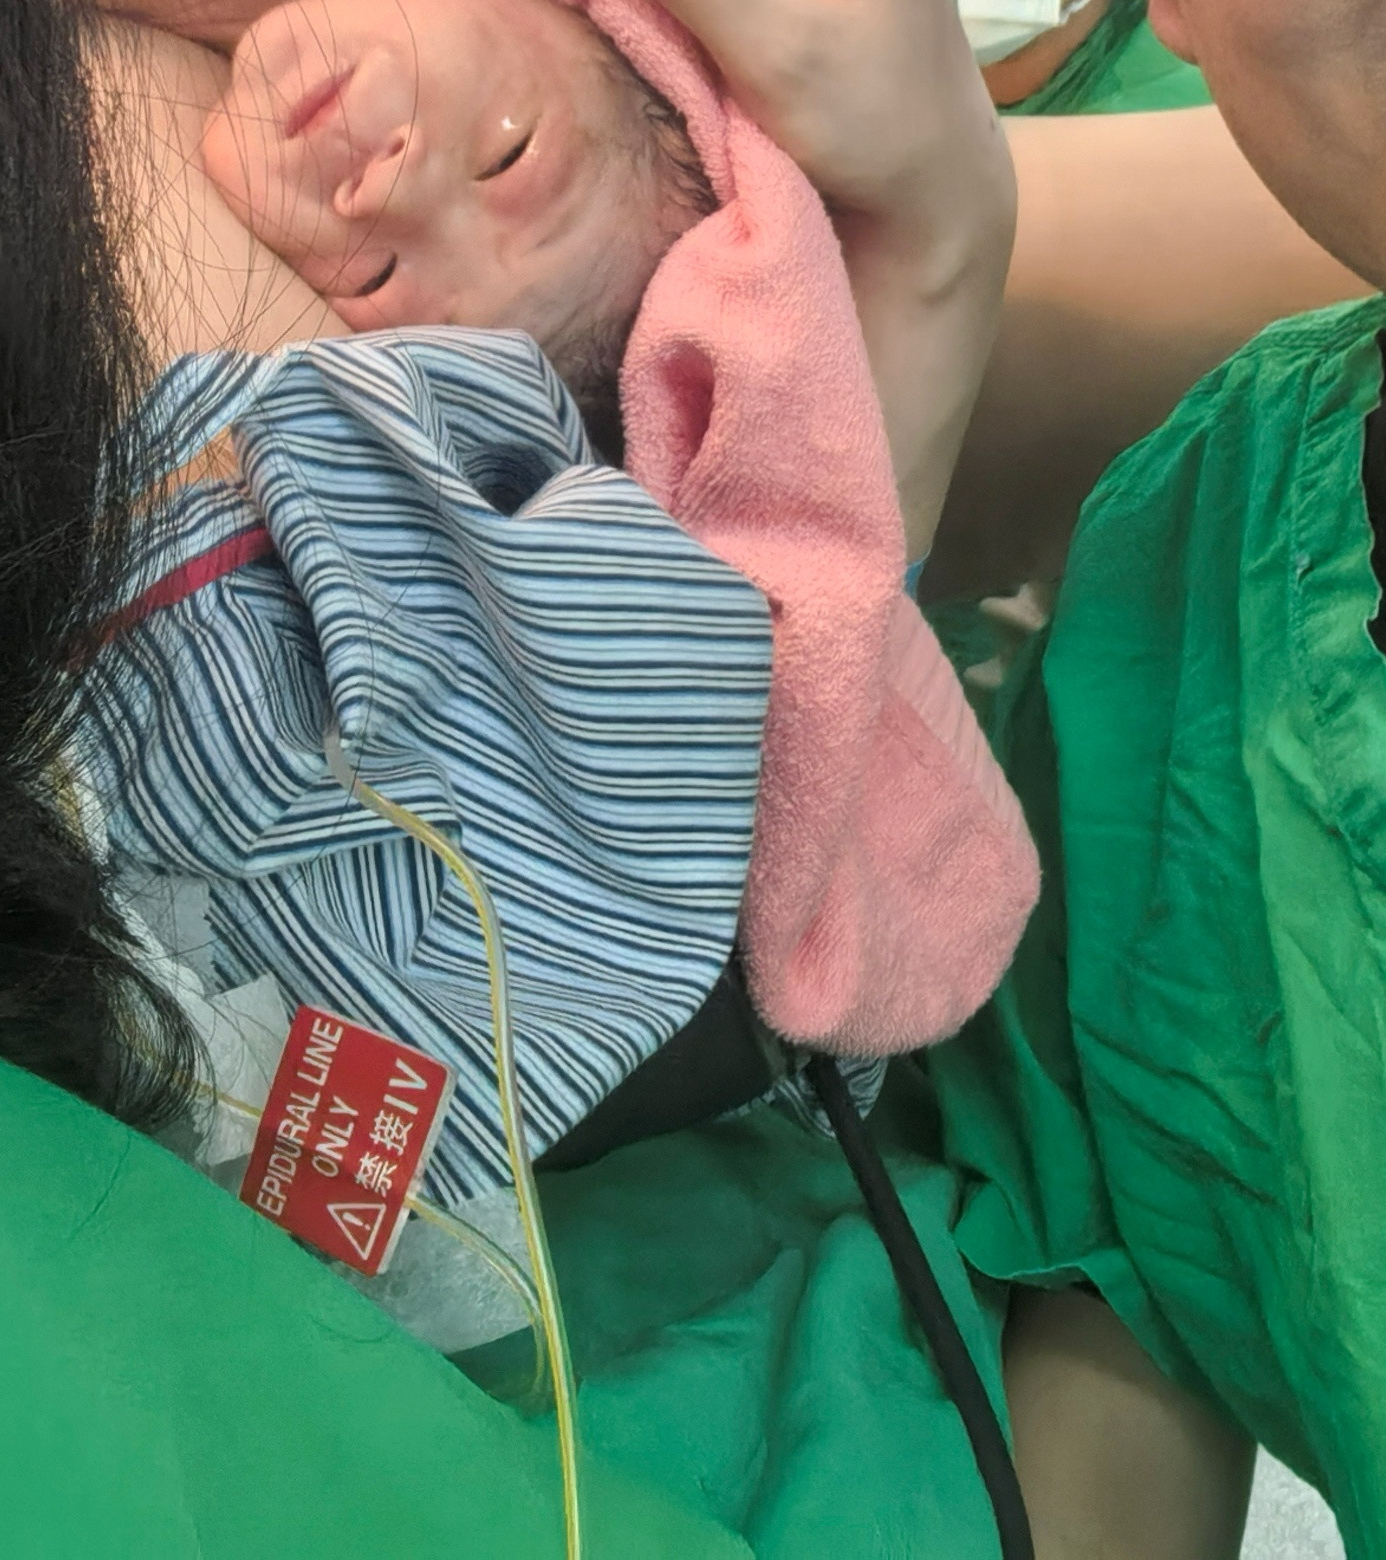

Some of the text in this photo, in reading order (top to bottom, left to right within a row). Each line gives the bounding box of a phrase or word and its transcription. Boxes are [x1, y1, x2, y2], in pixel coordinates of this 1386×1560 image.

[257, 1018, 344, 1217] EPIDURAL LINE
[311, 1095, 359, 1178] ONLY
